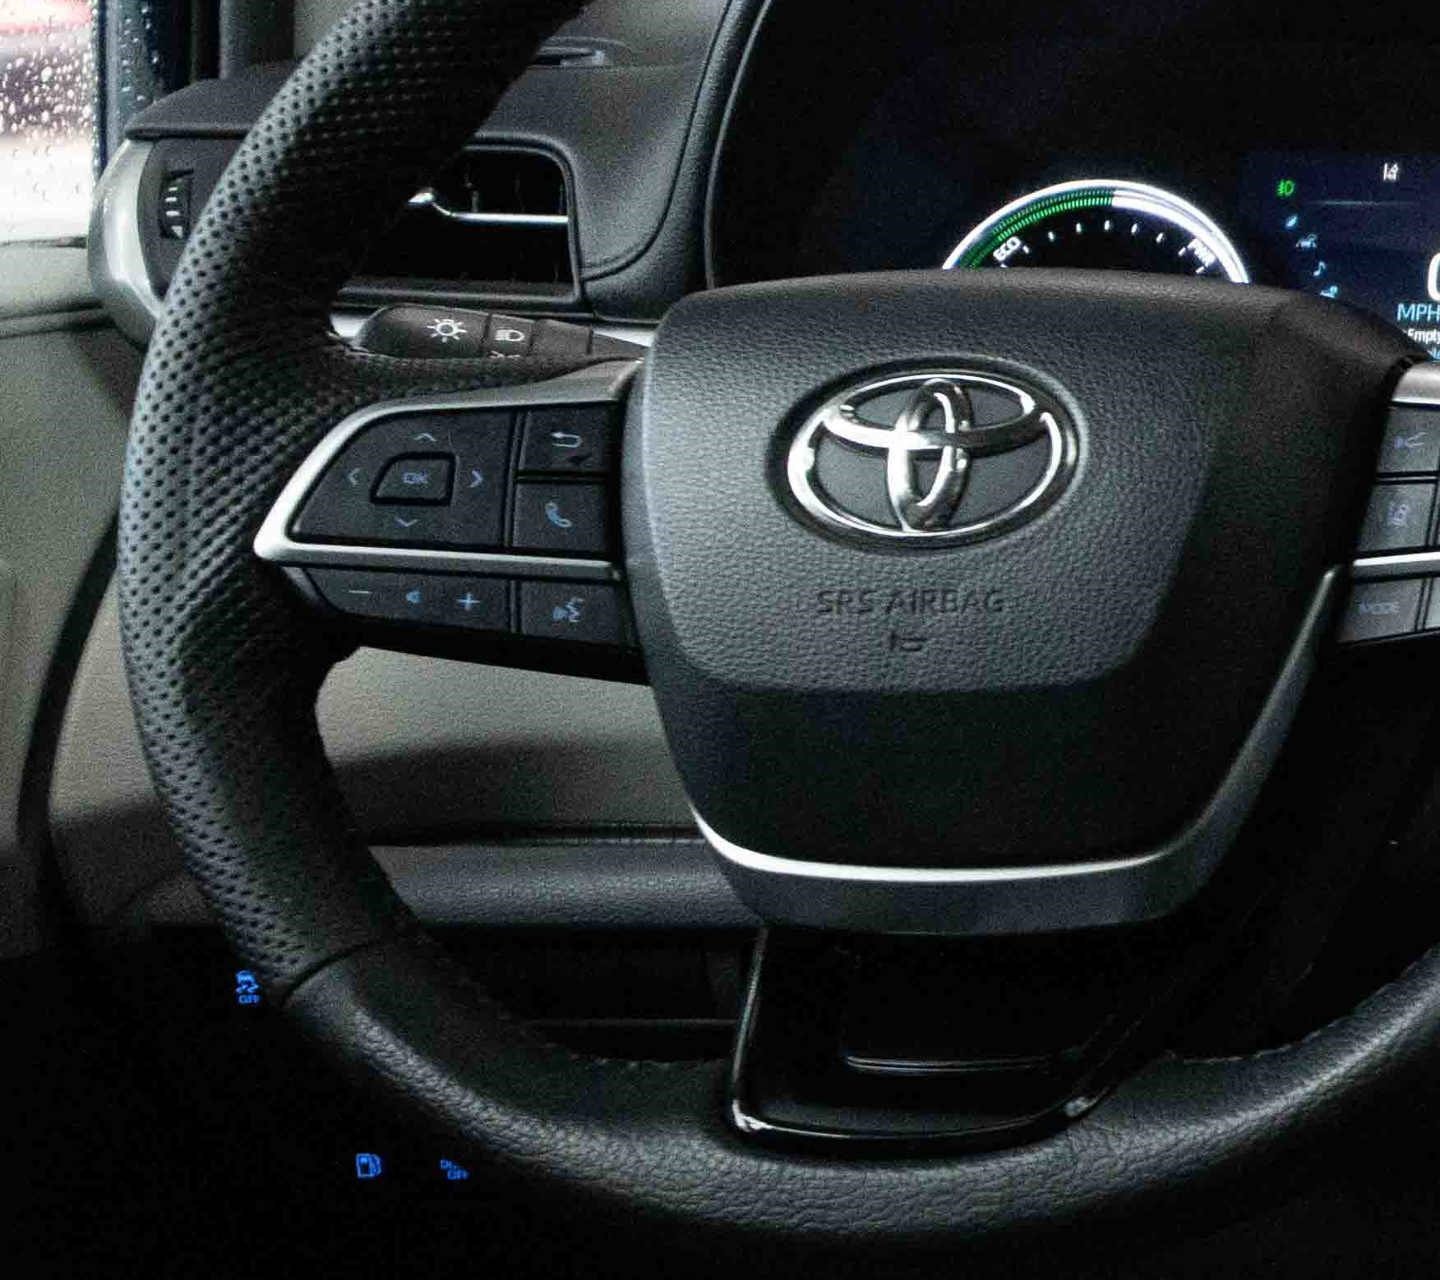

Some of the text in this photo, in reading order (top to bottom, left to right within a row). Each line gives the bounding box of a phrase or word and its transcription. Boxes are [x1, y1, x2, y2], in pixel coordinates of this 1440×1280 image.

[992, 235, 1021, 261] ECO
[1396, 303, 1440, 322] MPH
[817, 587, 1003, 615] SRS AIRBAG
